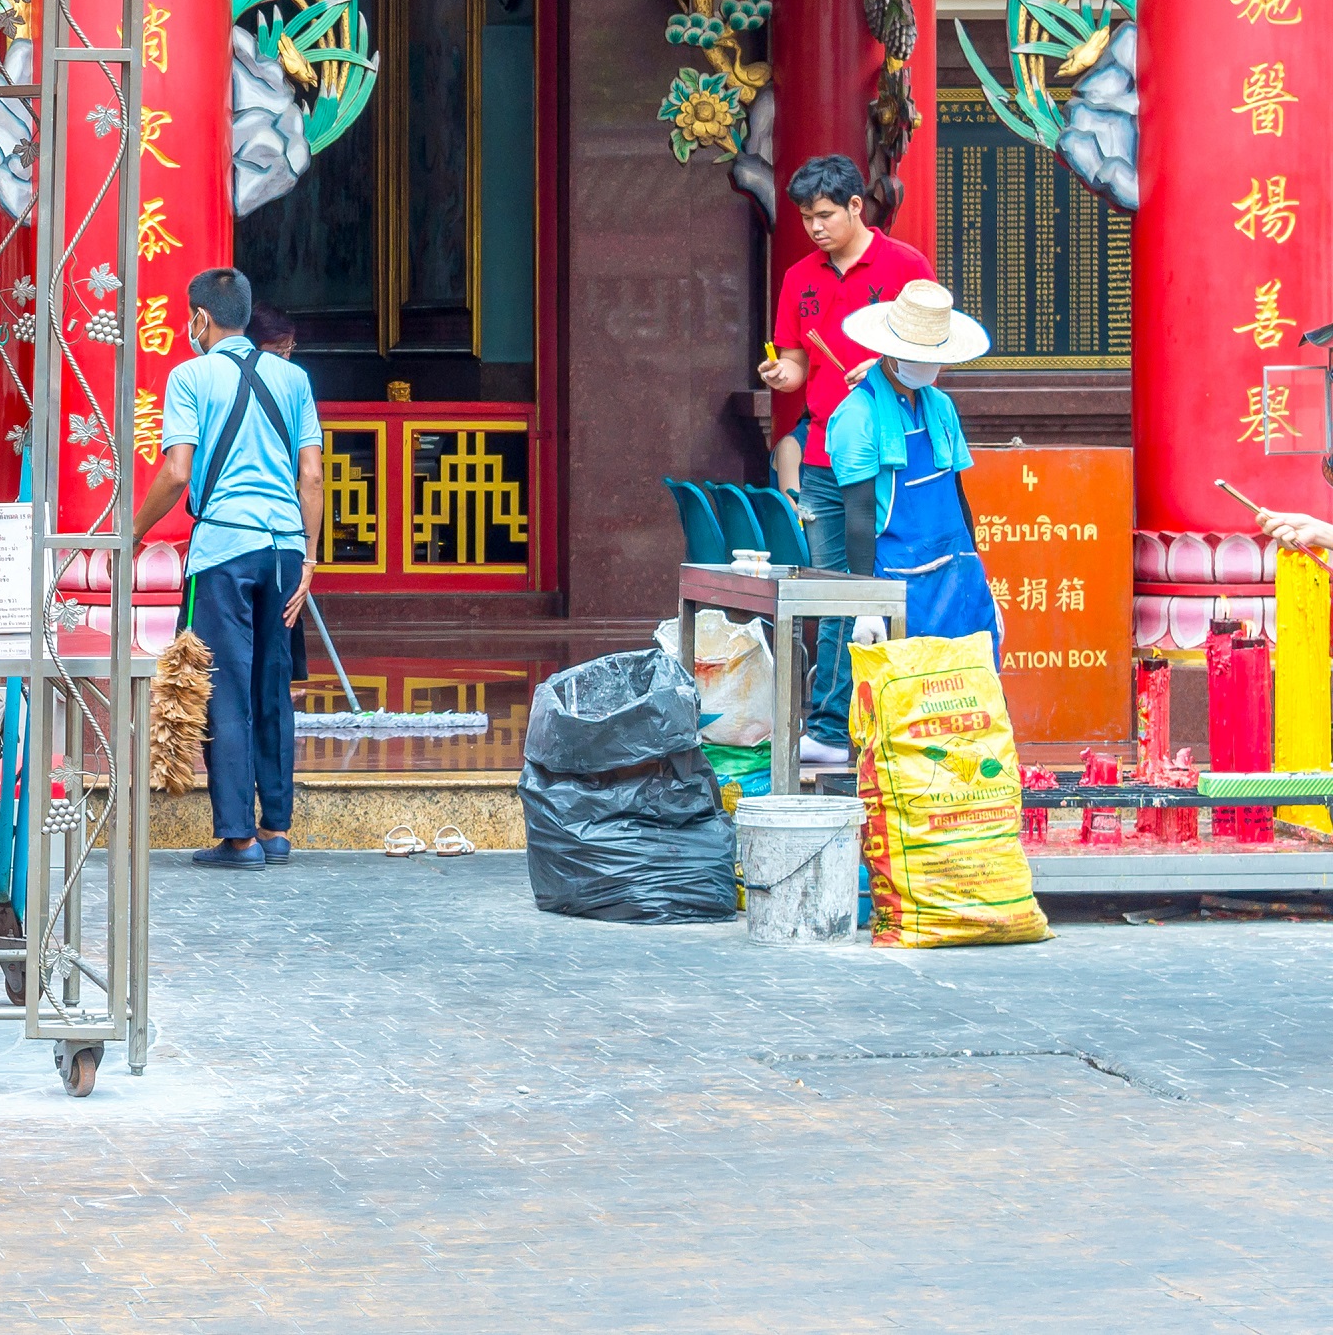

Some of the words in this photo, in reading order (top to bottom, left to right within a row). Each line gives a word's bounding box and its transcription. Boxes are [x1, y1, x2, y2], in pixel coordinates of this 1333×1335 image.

[1022, 465, 1039, 492] 4
[974, 515, 1098, 552] ตู้รับบริจาค
[1068, 650, 1108, 667] BOX
[918, 712, 984, 737] 18-8-8
